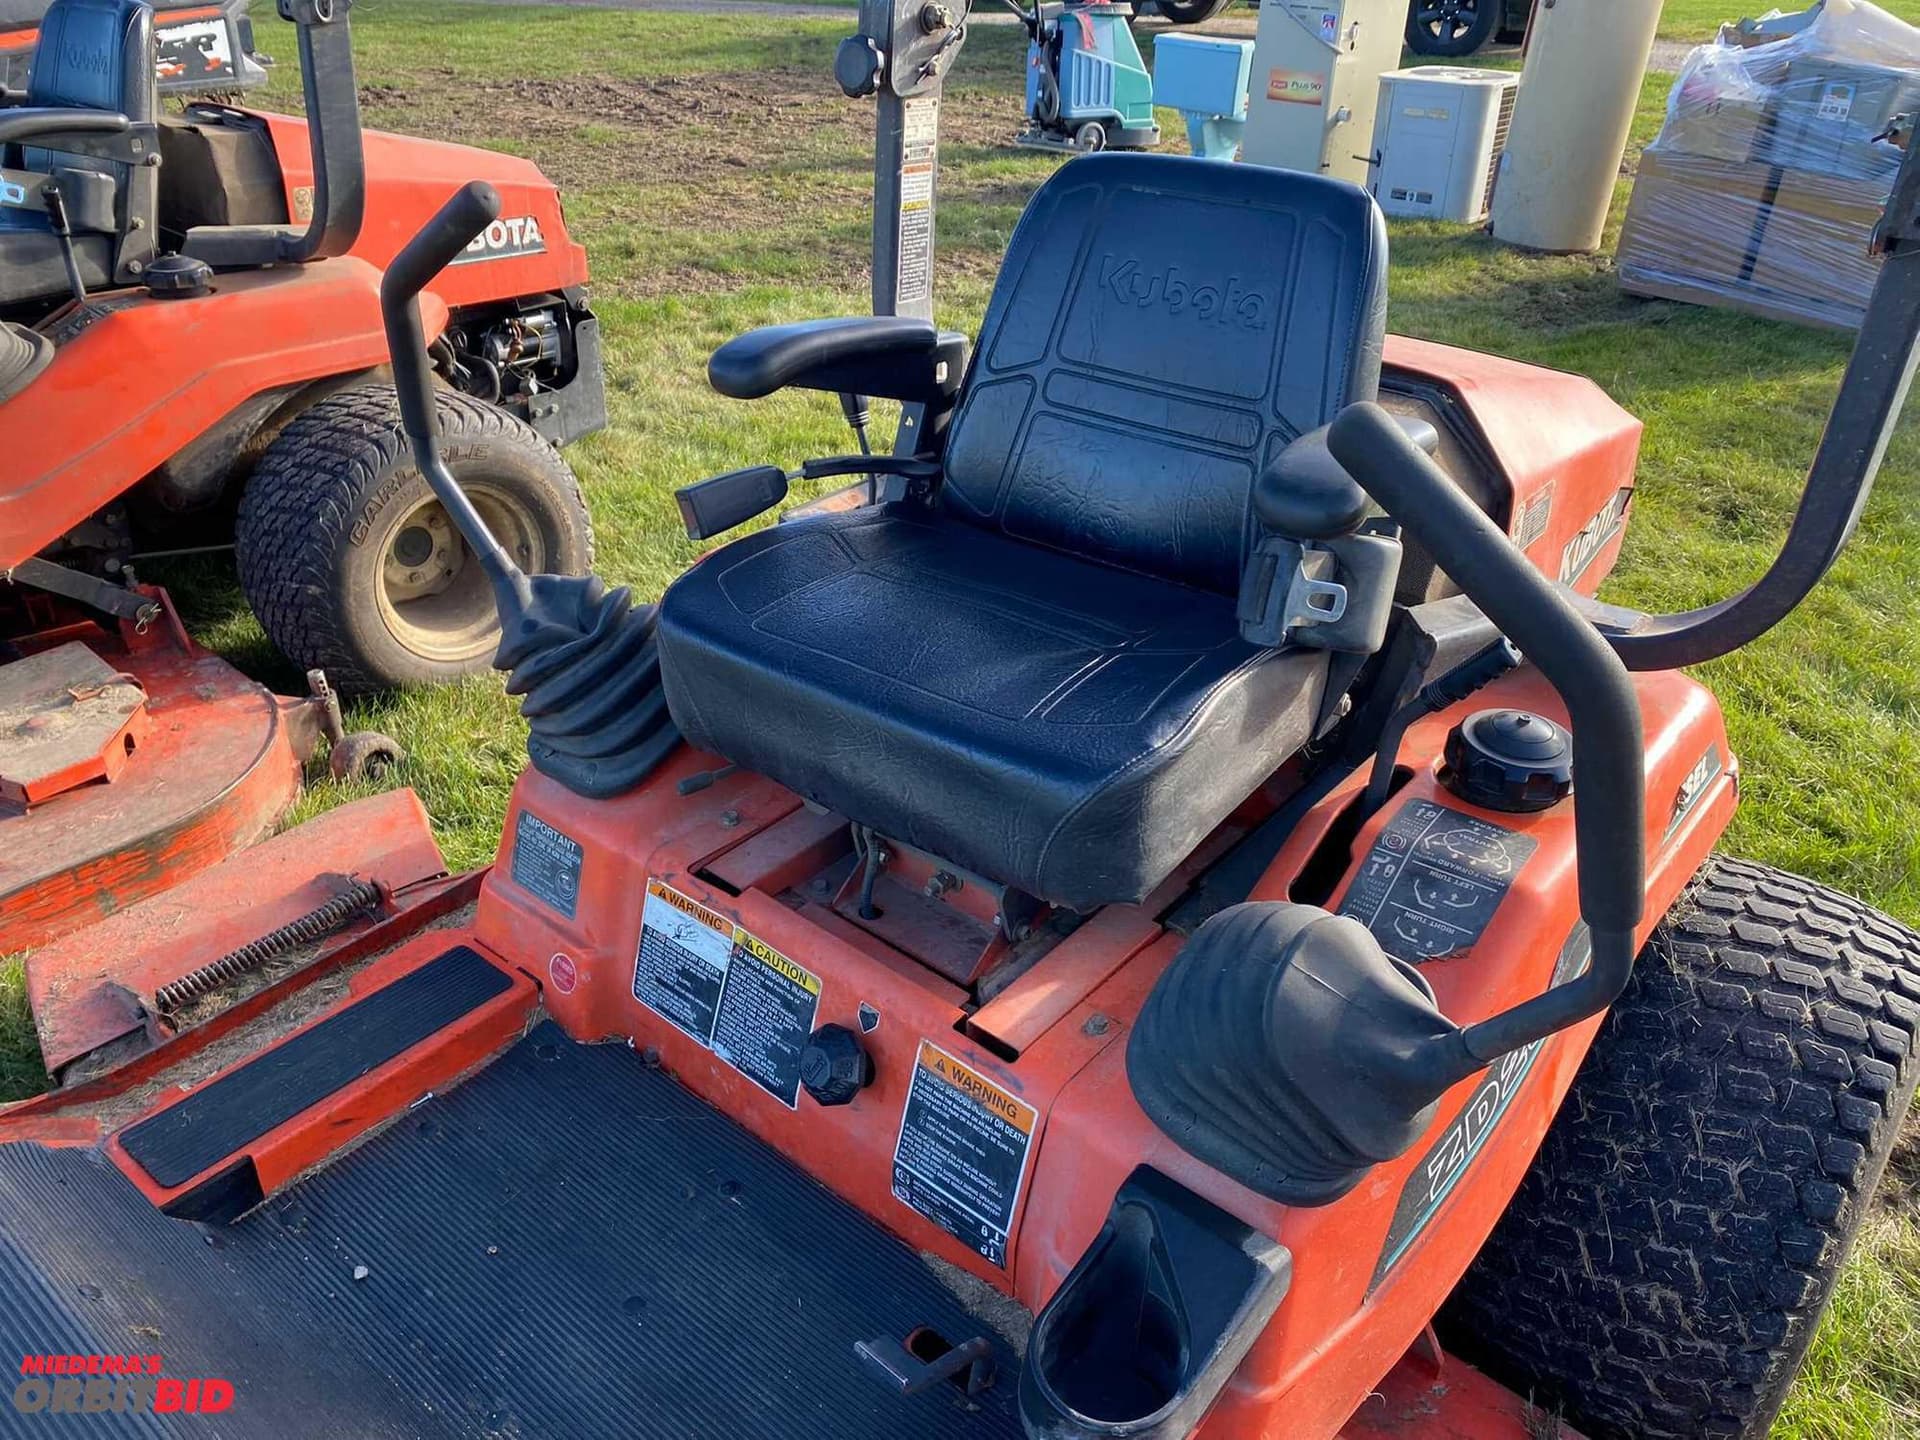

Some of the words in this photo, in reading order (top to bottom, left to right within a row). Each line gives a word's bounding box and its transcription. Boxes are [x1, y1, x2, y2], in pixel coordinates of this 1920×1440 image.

[1098, 255, 1265, 330] Kubota
[526, 814, 576, 851] IMPORTANT
[1429, 870, 1452, 884] TURN
[1453, 879, 1475, 891] LEFT
[669, 892, 722, 930] WARNING
[1404, 911, 1428, 926] TURN
[1430, 920, 1455, 936] RIGHT
[755, 943, 807, 986] CAUTION
[790, 983, 813, 1004] INJURY
[917, 1068, 926, 1080] TO
[993, 1118, 1004, 1131] OR
[1003, 1124, 1026, 1145] DEATH
[950, 1065, 1018, 1119] WARNING
[1428, 1039, 1539, 1202] ZD2
